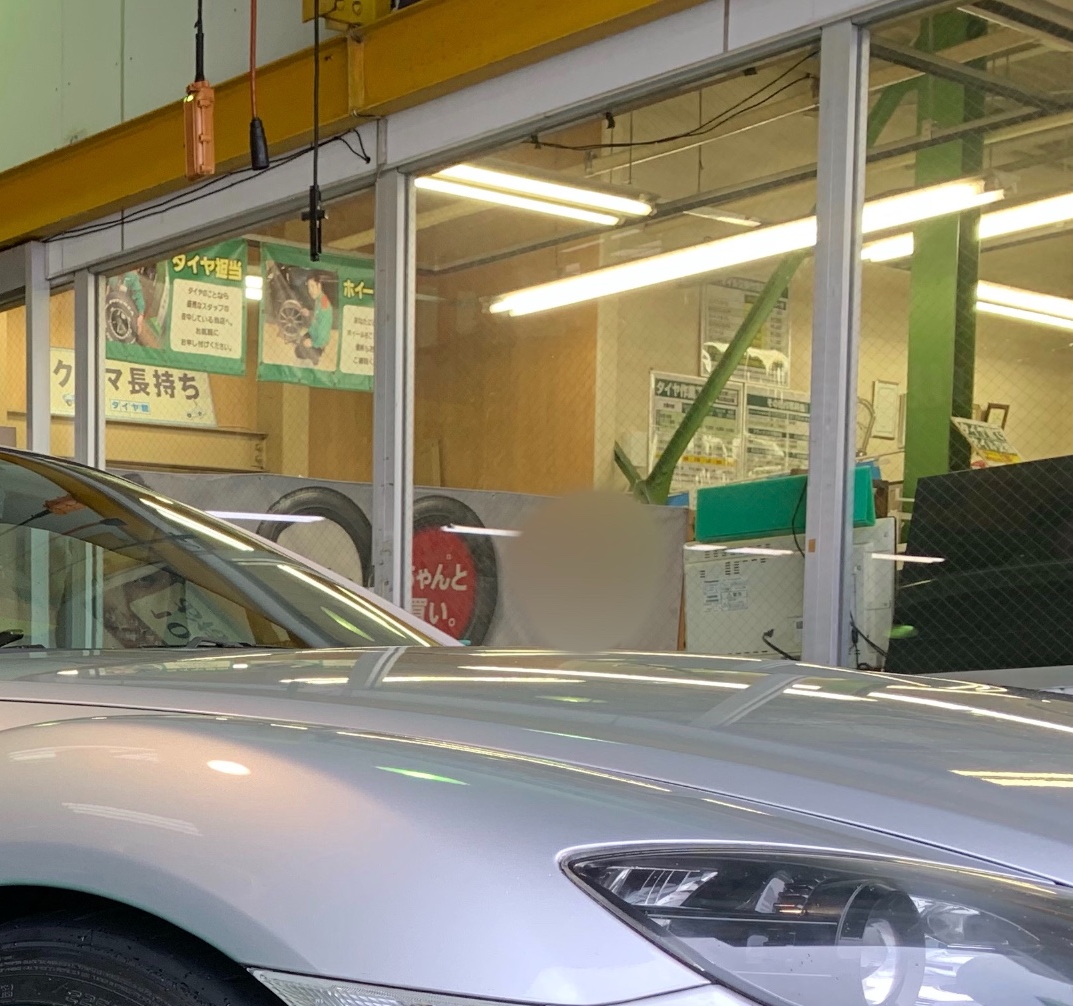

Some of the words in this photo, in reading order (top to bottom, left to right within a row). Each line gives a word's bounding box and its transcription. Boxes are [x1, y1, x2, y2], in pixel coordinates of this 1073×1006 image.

[172, 254, 242, 280] タイヤ担当
[53, 359, 200, 400] クマ長持ち
[412, 563, 467, 591] ゃんと
